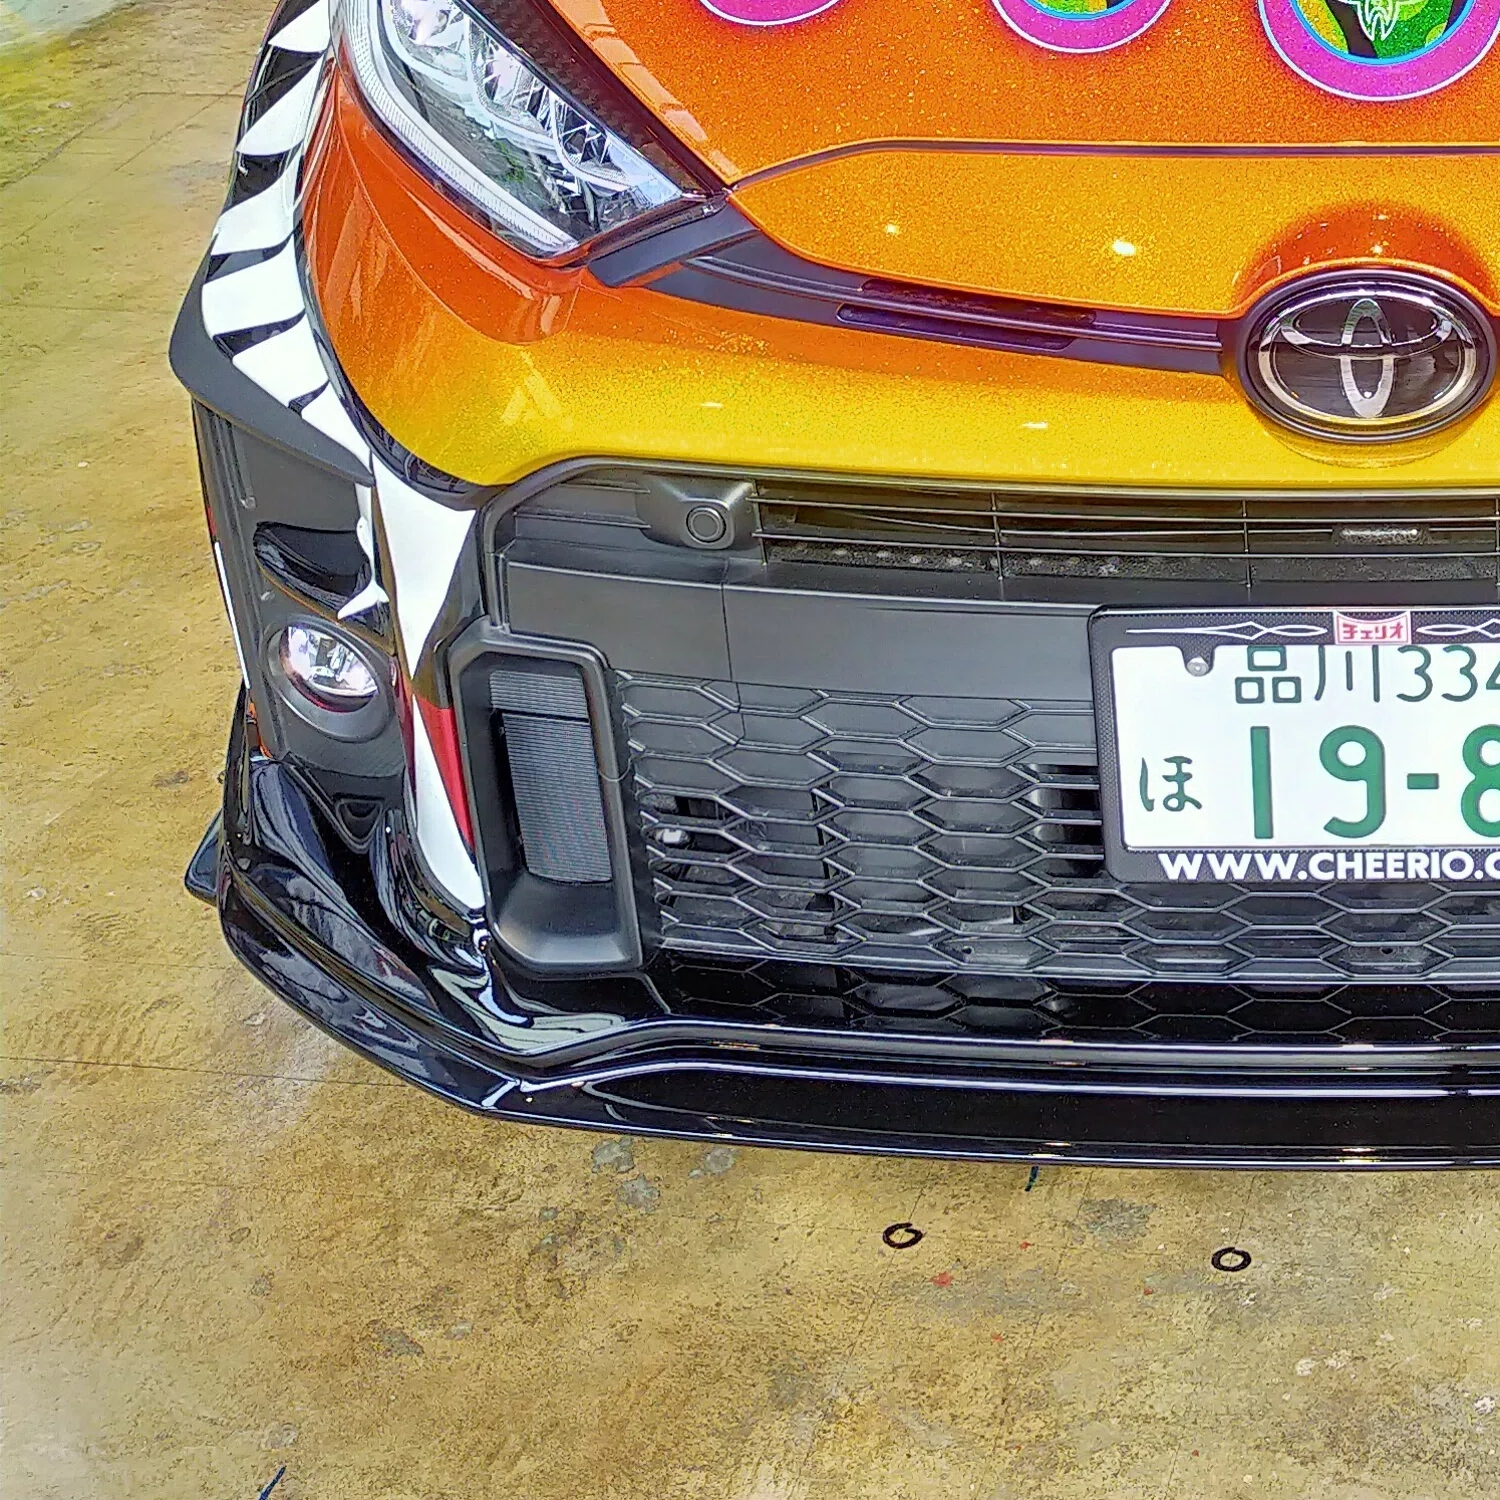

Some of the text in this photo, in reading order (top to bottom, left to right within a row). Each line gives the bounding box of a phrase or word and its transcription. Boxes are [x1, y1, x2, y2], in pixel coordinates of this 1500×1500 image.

[1342, 621, 1403, 640] チェリオ
[1139, 755, 1203, 812] ほ
